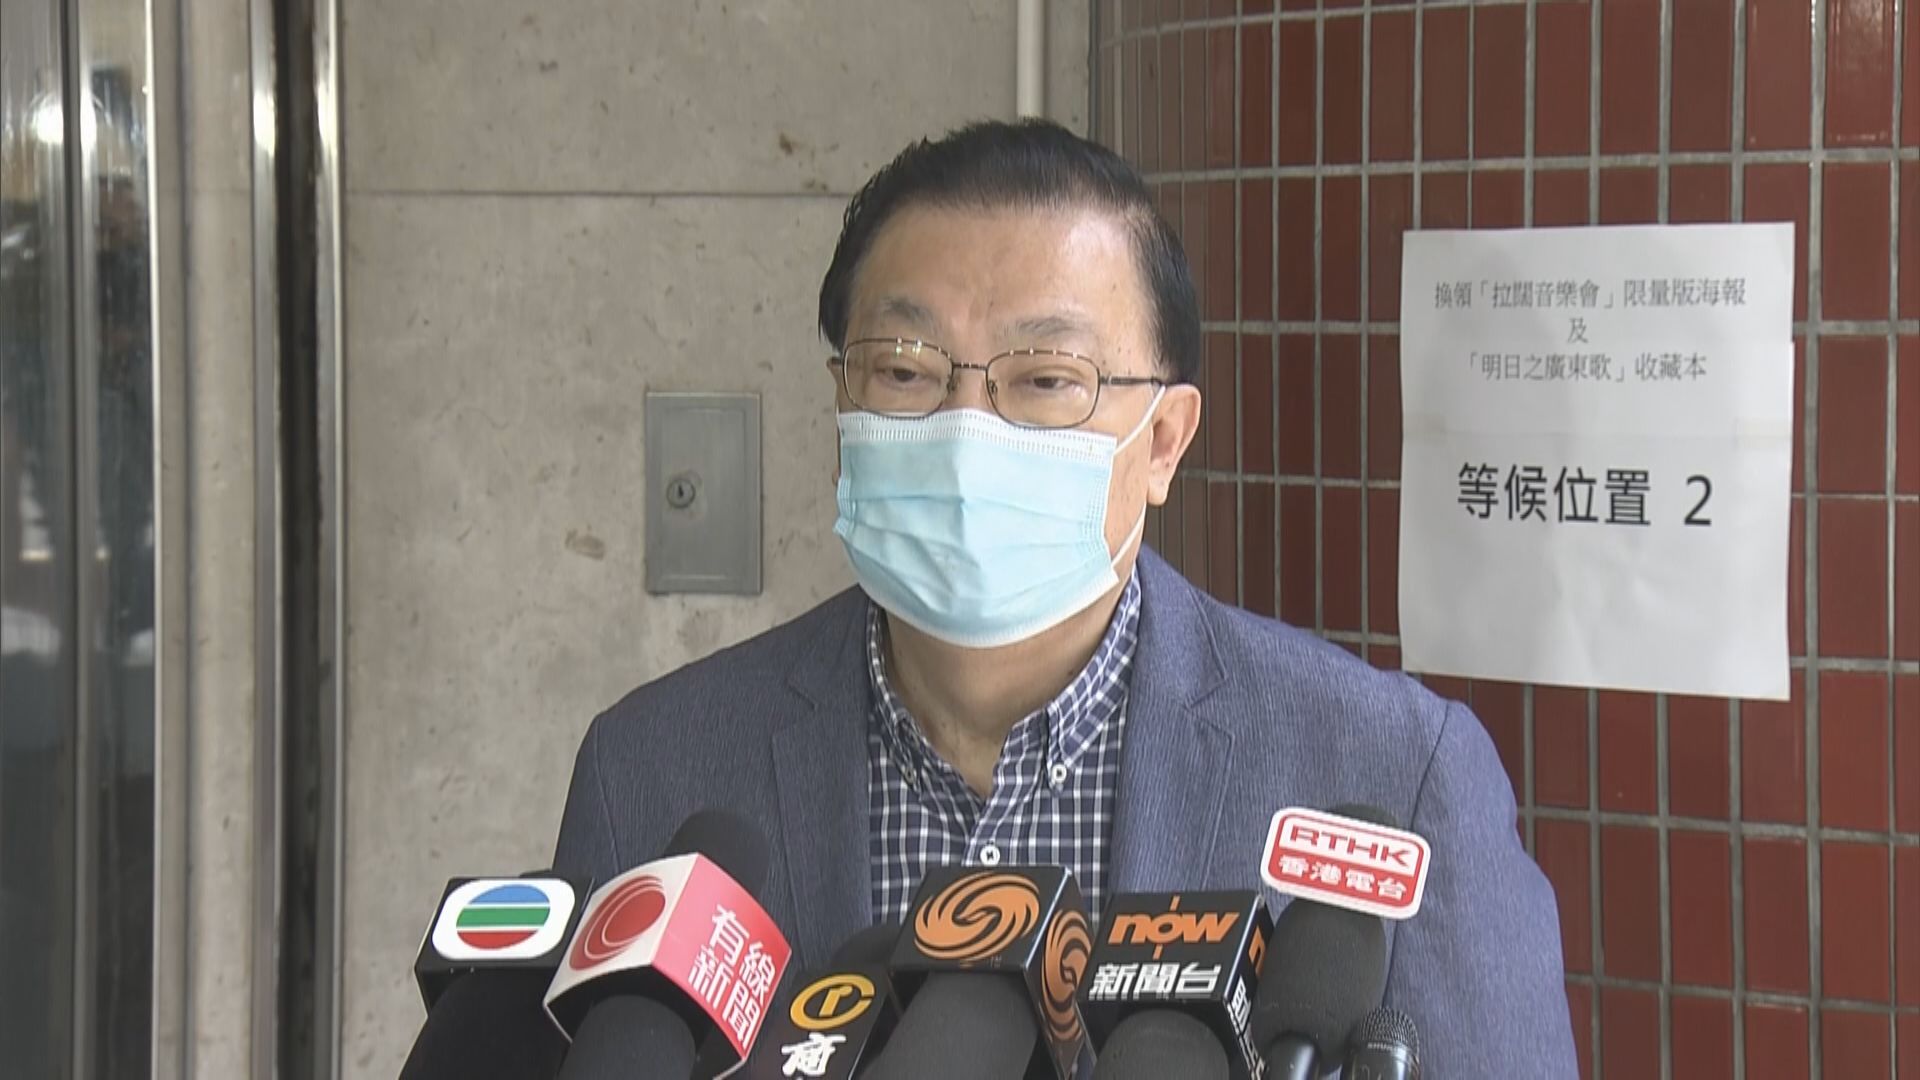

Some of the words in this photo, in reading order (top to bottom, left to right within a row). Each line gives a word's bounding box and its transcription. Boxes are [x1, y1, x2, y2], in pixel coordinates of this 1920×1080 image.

[1567, 316, 1588, 344] 及
[1457, 462, 1652, 526] 等候位置
[1683, 475, 1713, 526] 2
[1290, 824, 1411, 867] RTHK
[1278, 855, 1406, 900] 香港電台
[1108, 895, 1240, 960] now
[1088, 962, 1222, 1000] 新聞台
[781, 1032, 846, 1080] 商
